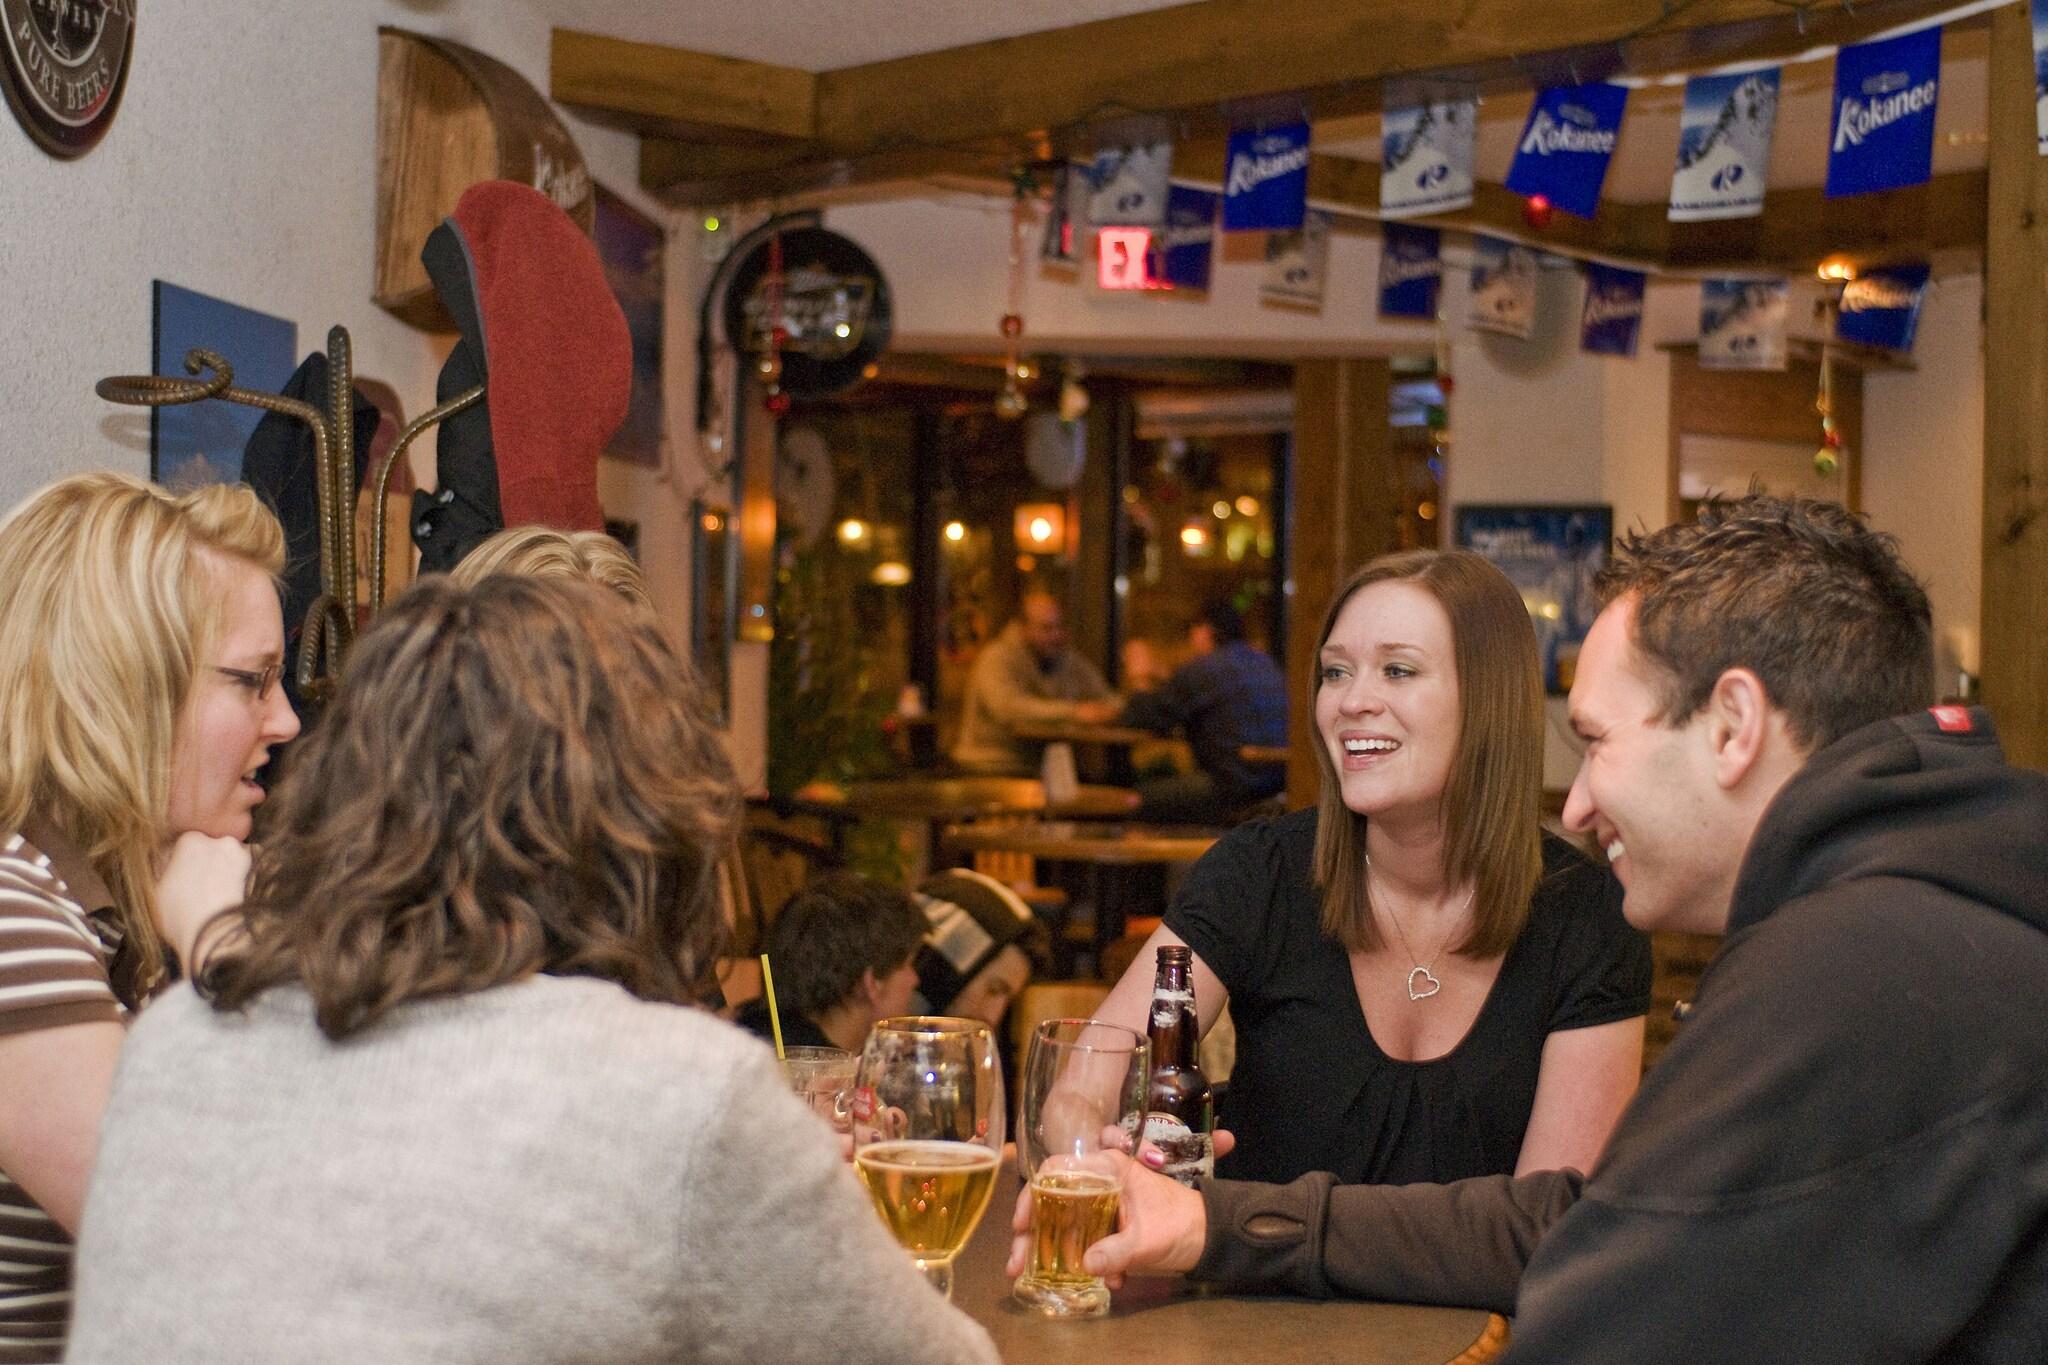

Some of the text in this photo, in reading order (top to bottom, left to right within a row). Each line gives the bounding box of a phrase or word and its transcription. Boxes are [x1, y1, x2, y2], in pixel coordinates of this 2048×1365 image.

[66, 57, 110, 110] BEERS
[1521, 107, 1616, 156] Kokanee
[1833, 80, 1935, 152] Kokanee
